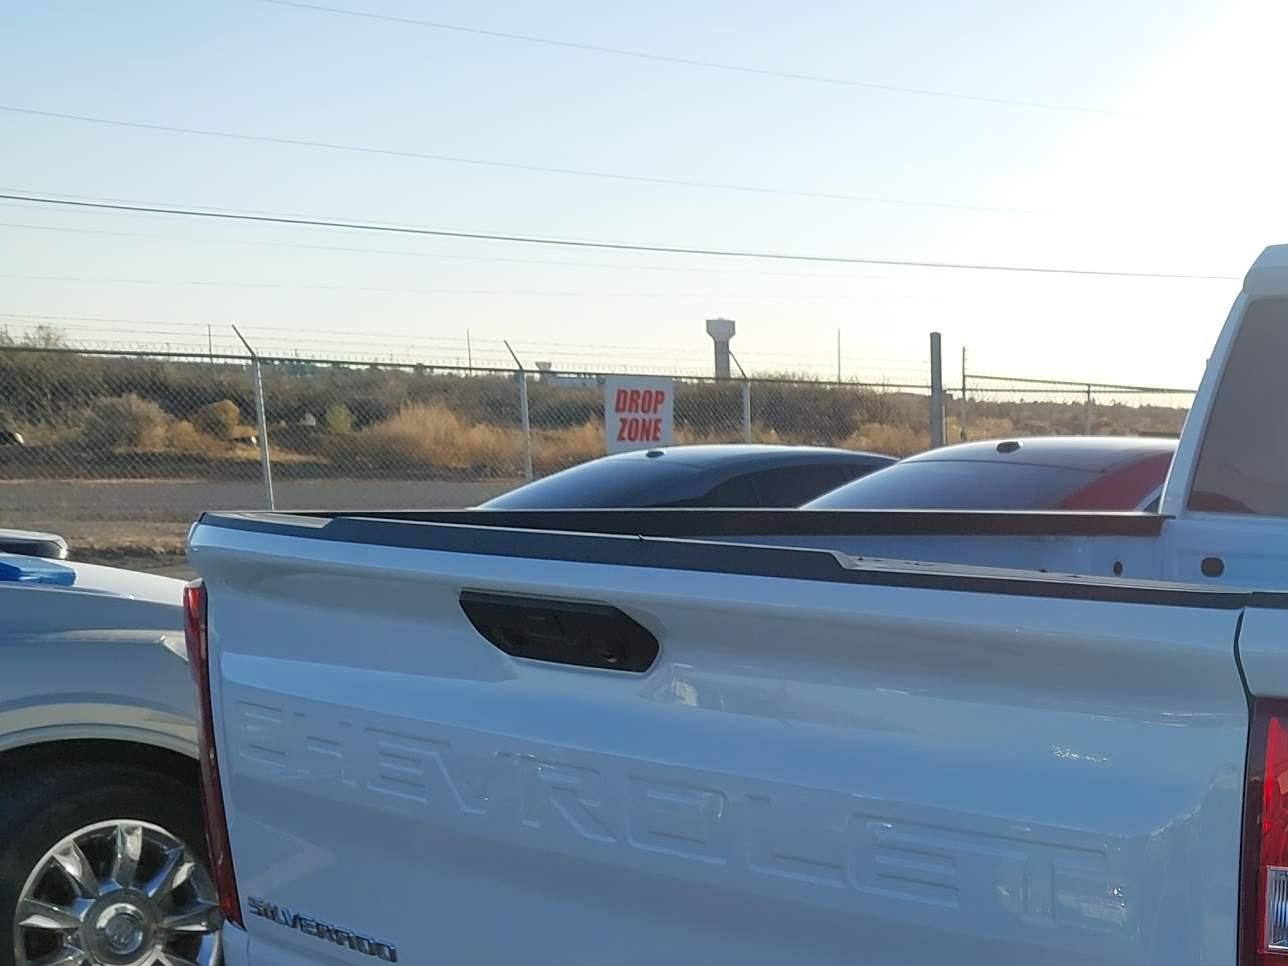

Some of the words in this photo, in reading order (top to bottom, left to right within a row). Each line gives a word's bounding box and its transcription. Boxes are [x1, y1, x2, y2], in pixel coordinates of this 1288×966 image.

[615, 389, 665, 414] DROP
[617, 418, 662, 442] ZONE
[236, 700, 1108, 926] CHEVROLET
[248, 897, 398, 963] SILVERADO
